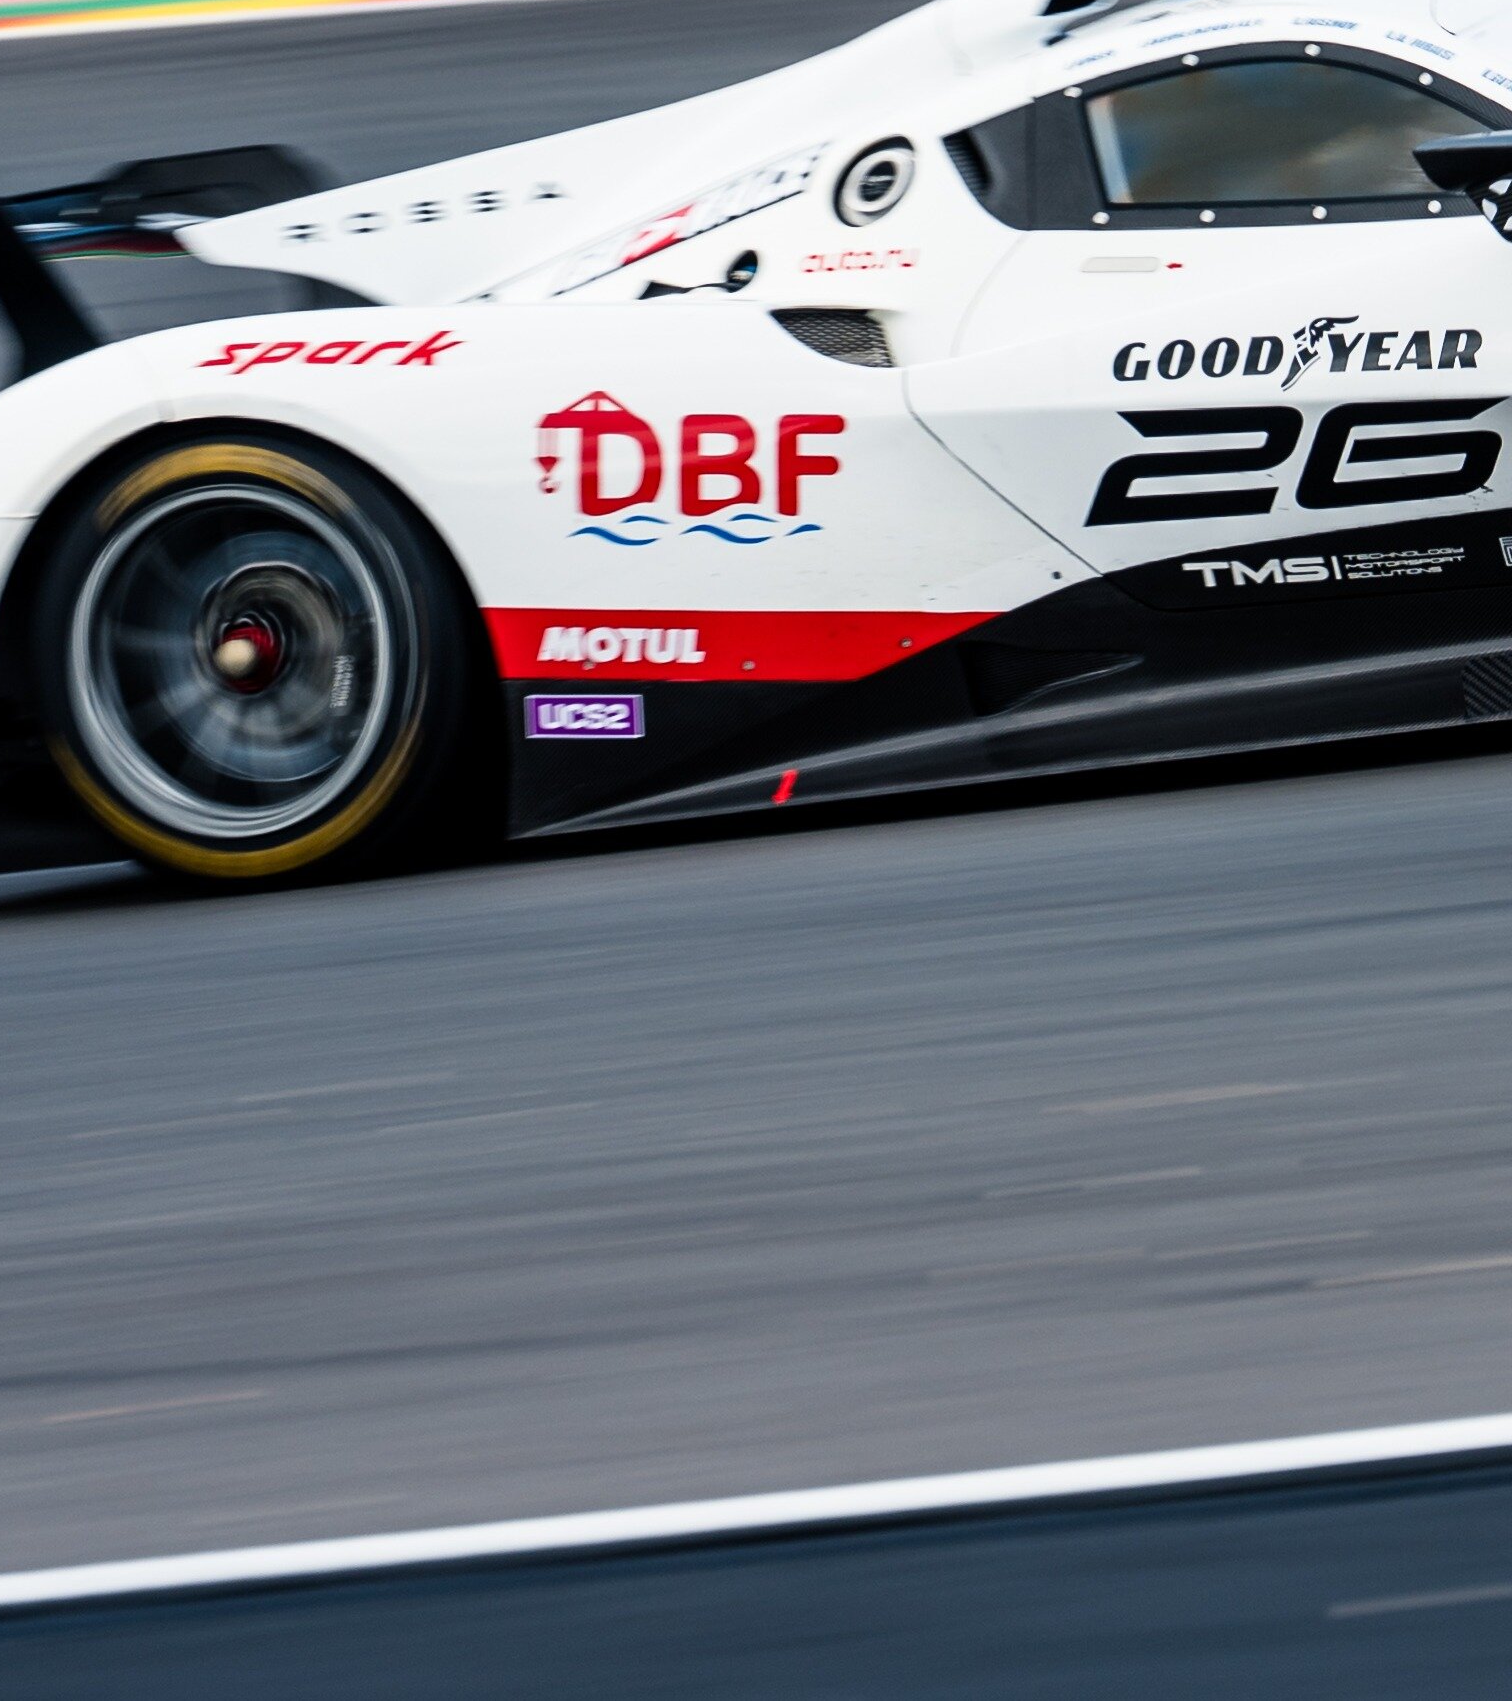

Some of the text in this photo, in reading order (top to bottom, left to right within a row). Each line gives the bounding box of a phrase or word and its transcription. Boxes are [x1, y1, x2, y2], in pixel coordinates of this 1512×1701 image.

[195, 330, 466, 374] spark
[573, 407, 848, 518] DBF
[1083, 395, 1510, 528] 26
[1343, 547, 1464, 561] TECHNOLOGY
[1345, 555, 1465, 570] MOTORSPORT
[1182, 556, 1333, 590] TMS
[1347, 566, 1443, 579] SOLUTIONS
[537, 626, 706, 664] MOTUL
[537, 702, 631, 731] UCS2
